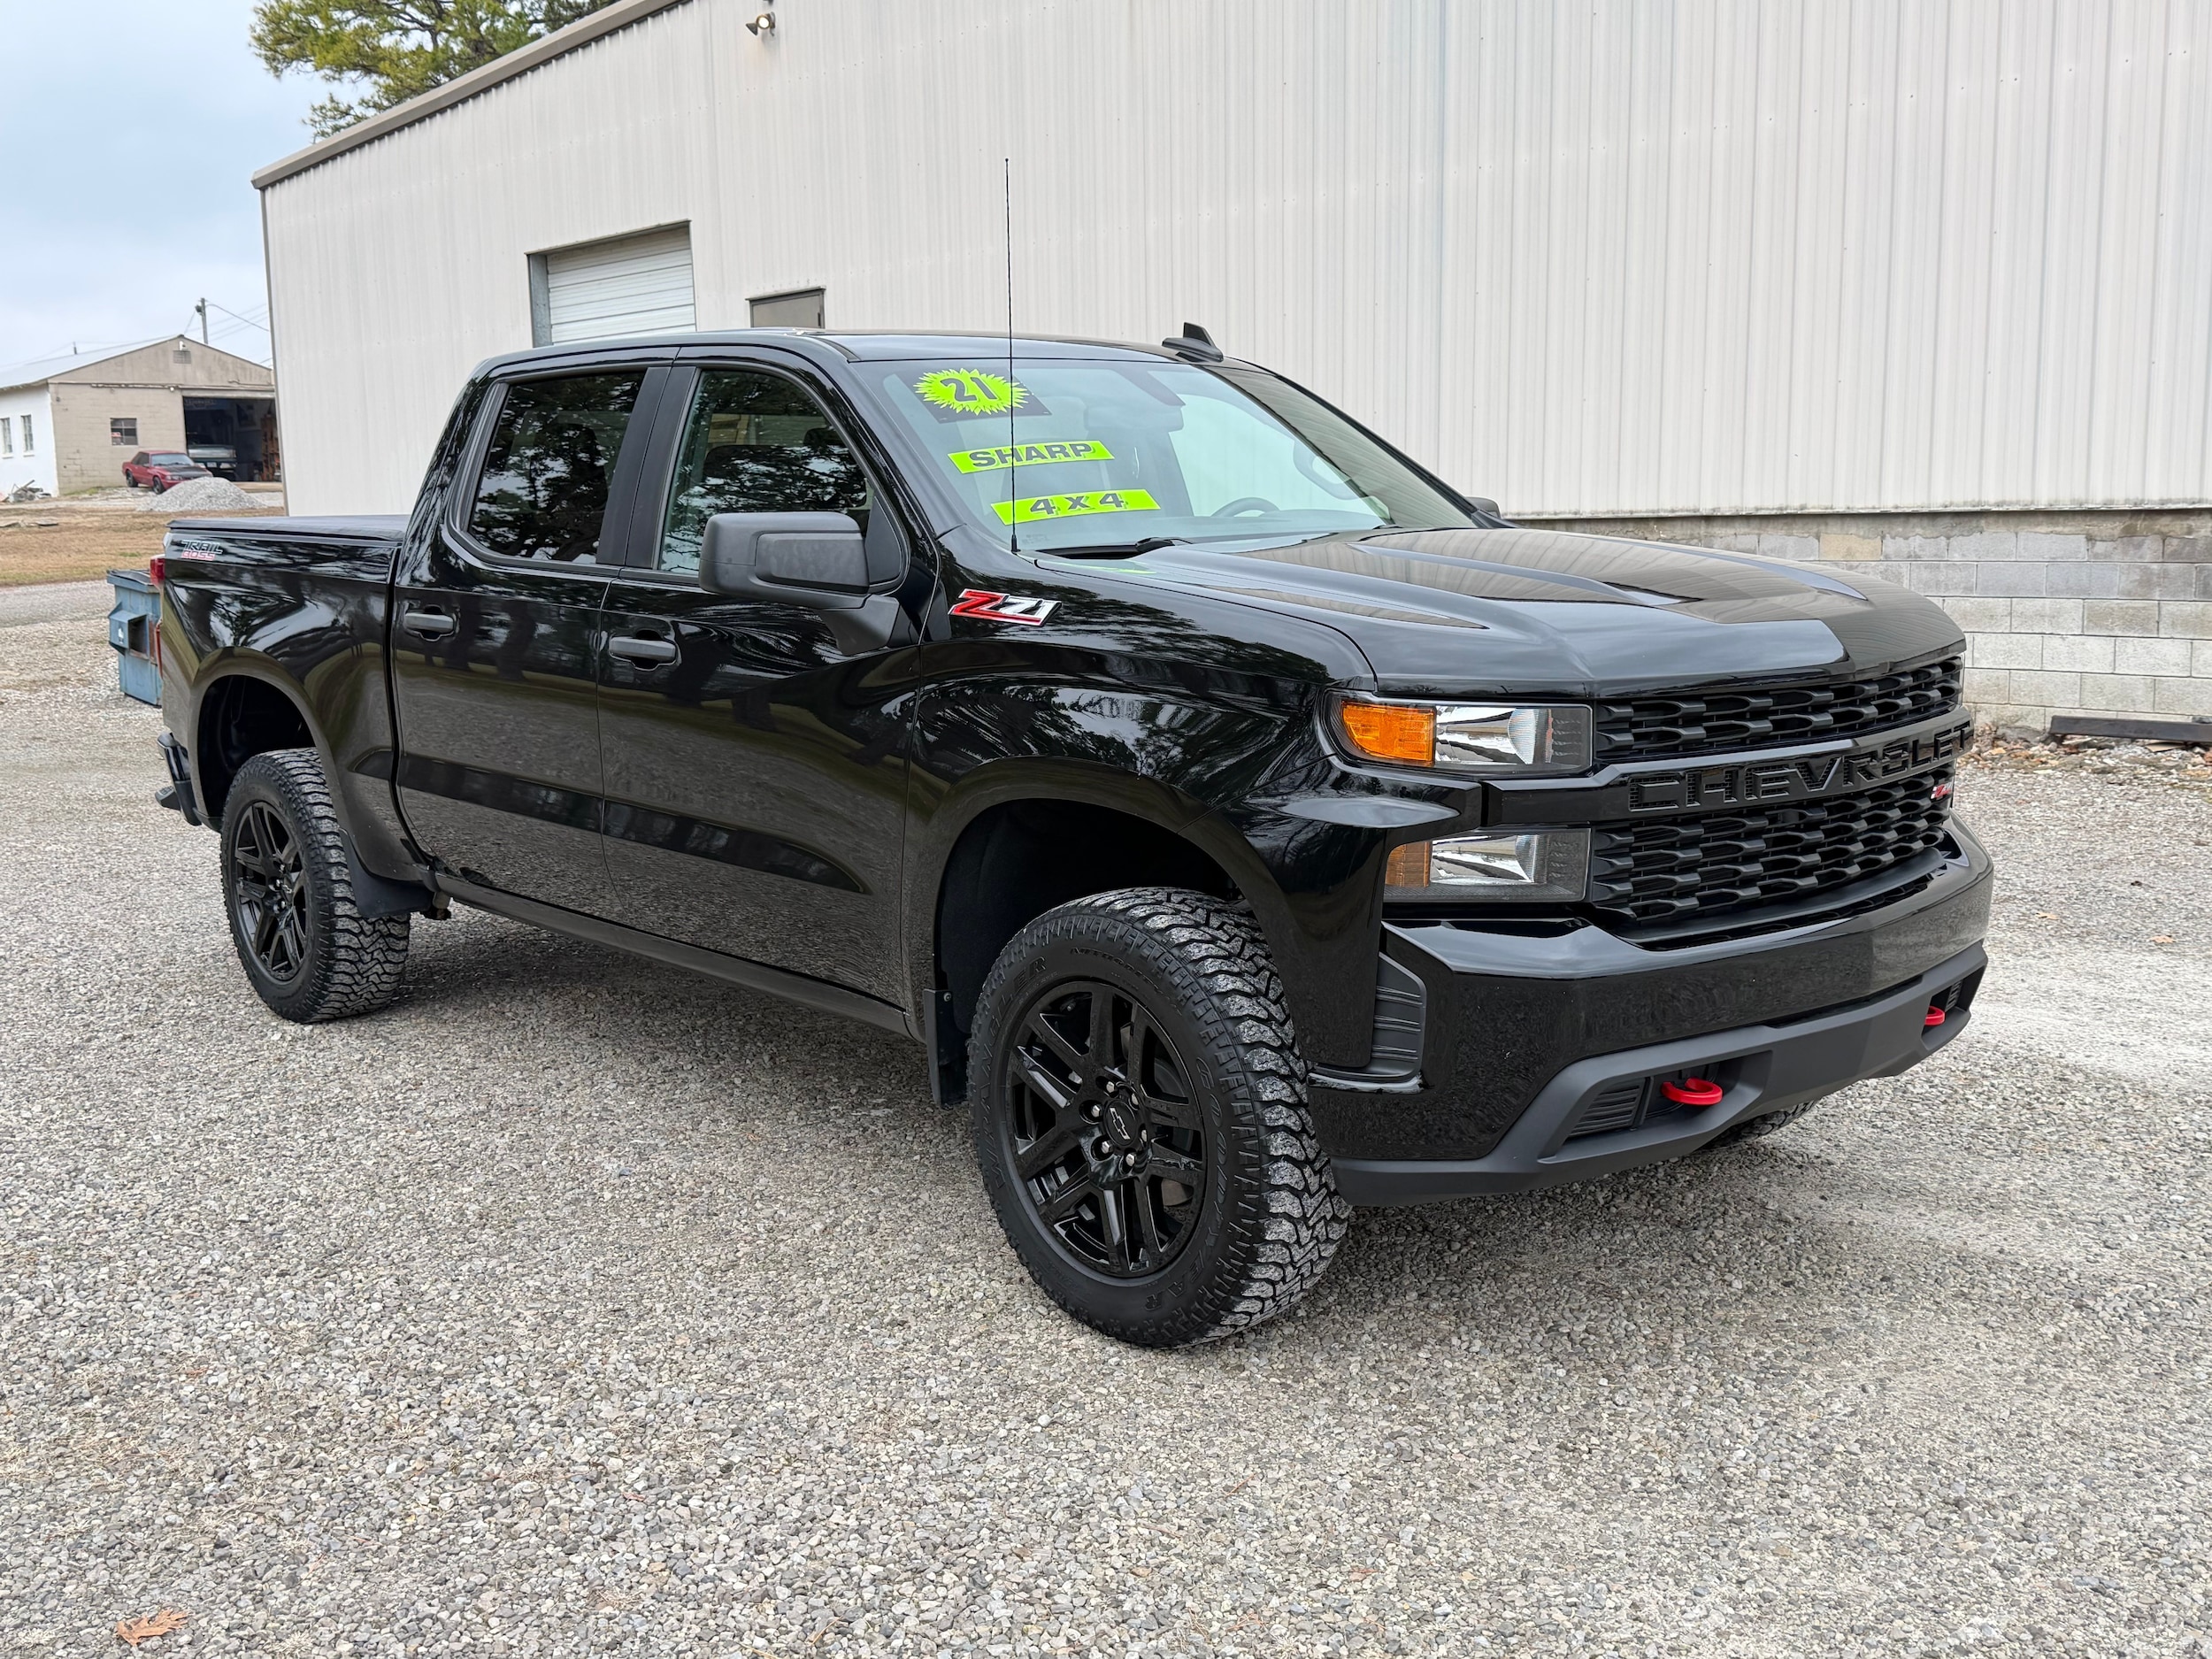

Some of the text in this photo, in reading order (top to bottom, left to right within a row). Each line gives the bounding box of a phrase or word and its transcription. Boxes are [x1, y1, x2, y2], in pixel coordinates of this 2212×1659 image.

[940, 377, 998, 403] 21
[969, 443, 1092, 467] SHARP
[181, 540, 223, 555] TRAIL
[181, 550, 216, 561] BOSS
[948, 588, 1062, 626] Z71
[1628, 720, 1971, 812] CHEVROLET
